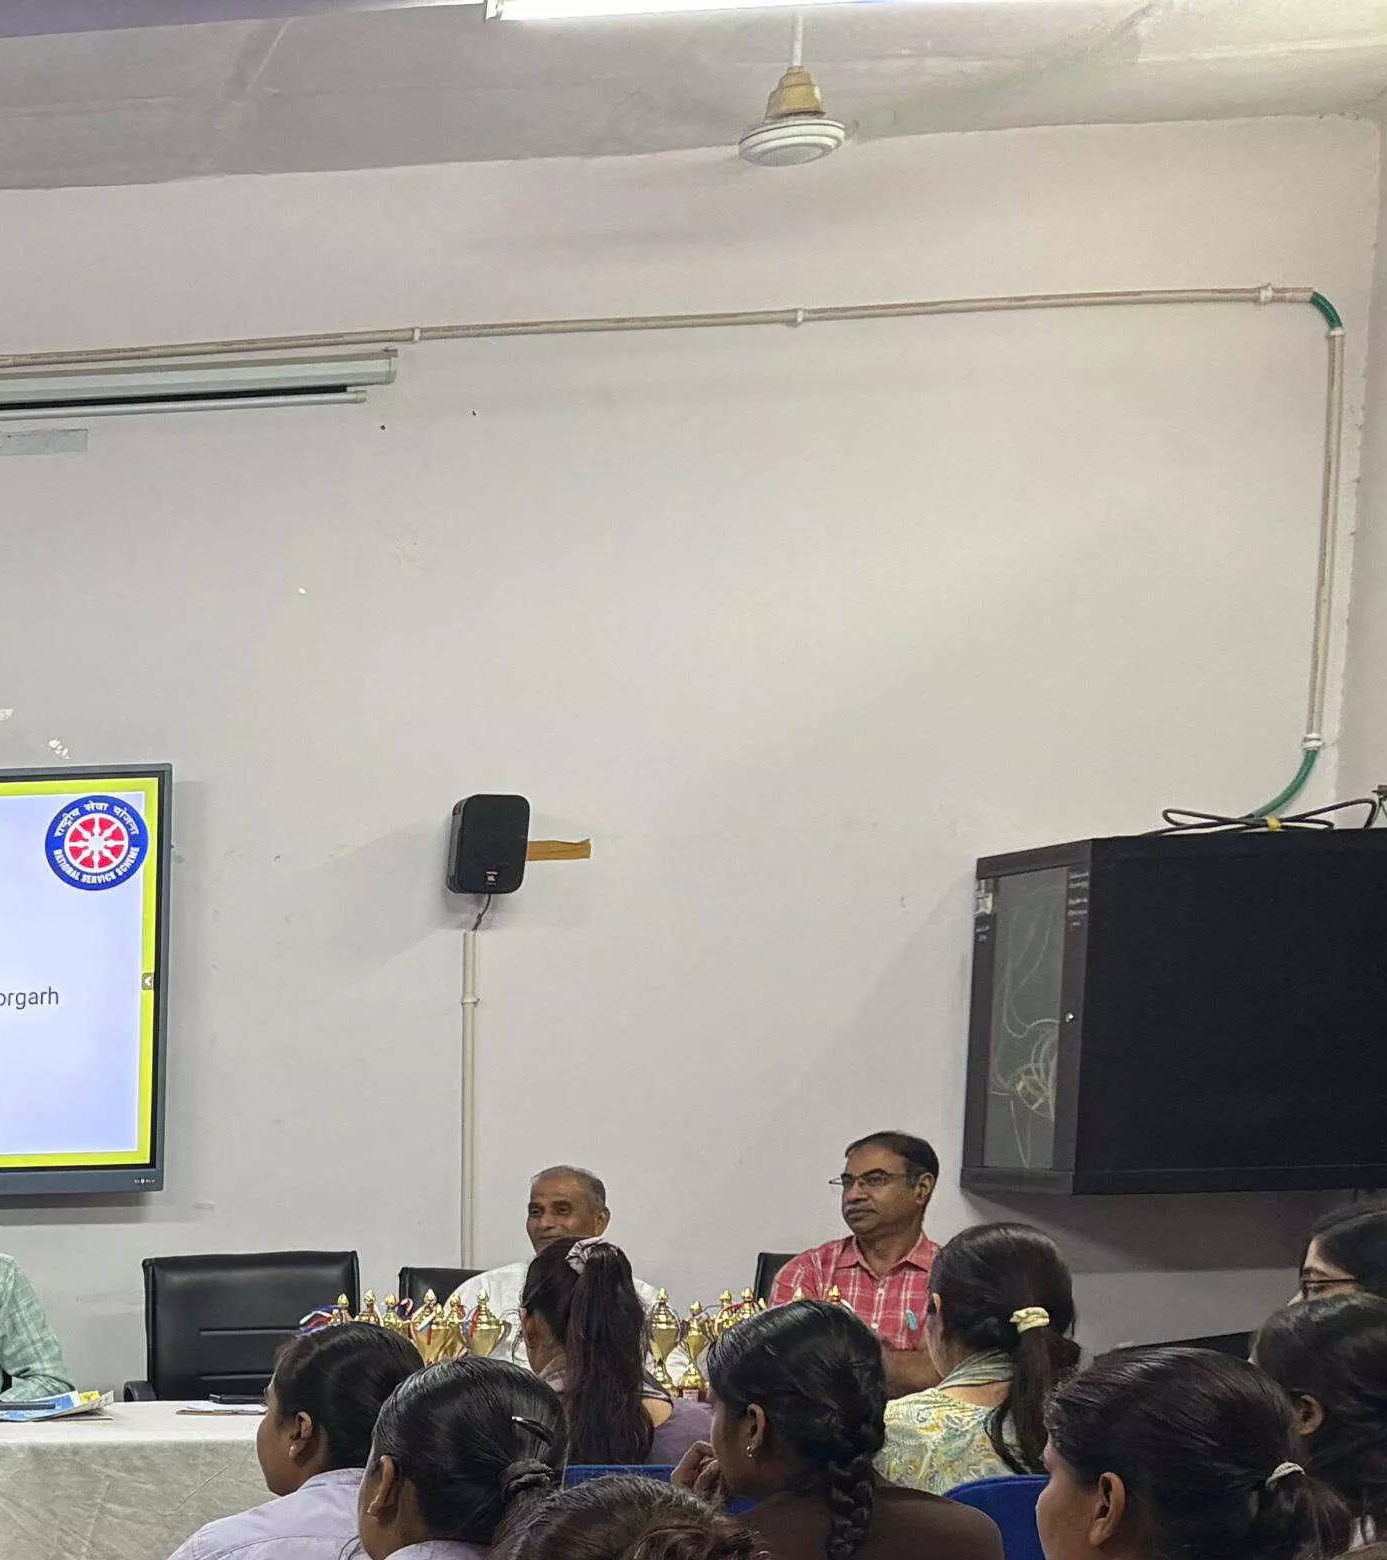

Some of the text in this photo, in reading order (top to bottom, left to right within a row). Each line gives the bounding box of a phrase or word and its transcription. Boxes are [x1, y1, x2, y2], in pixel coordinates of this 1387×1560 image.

[53, 846, 140, 885] NATIONAL SERVICE SCHEME
